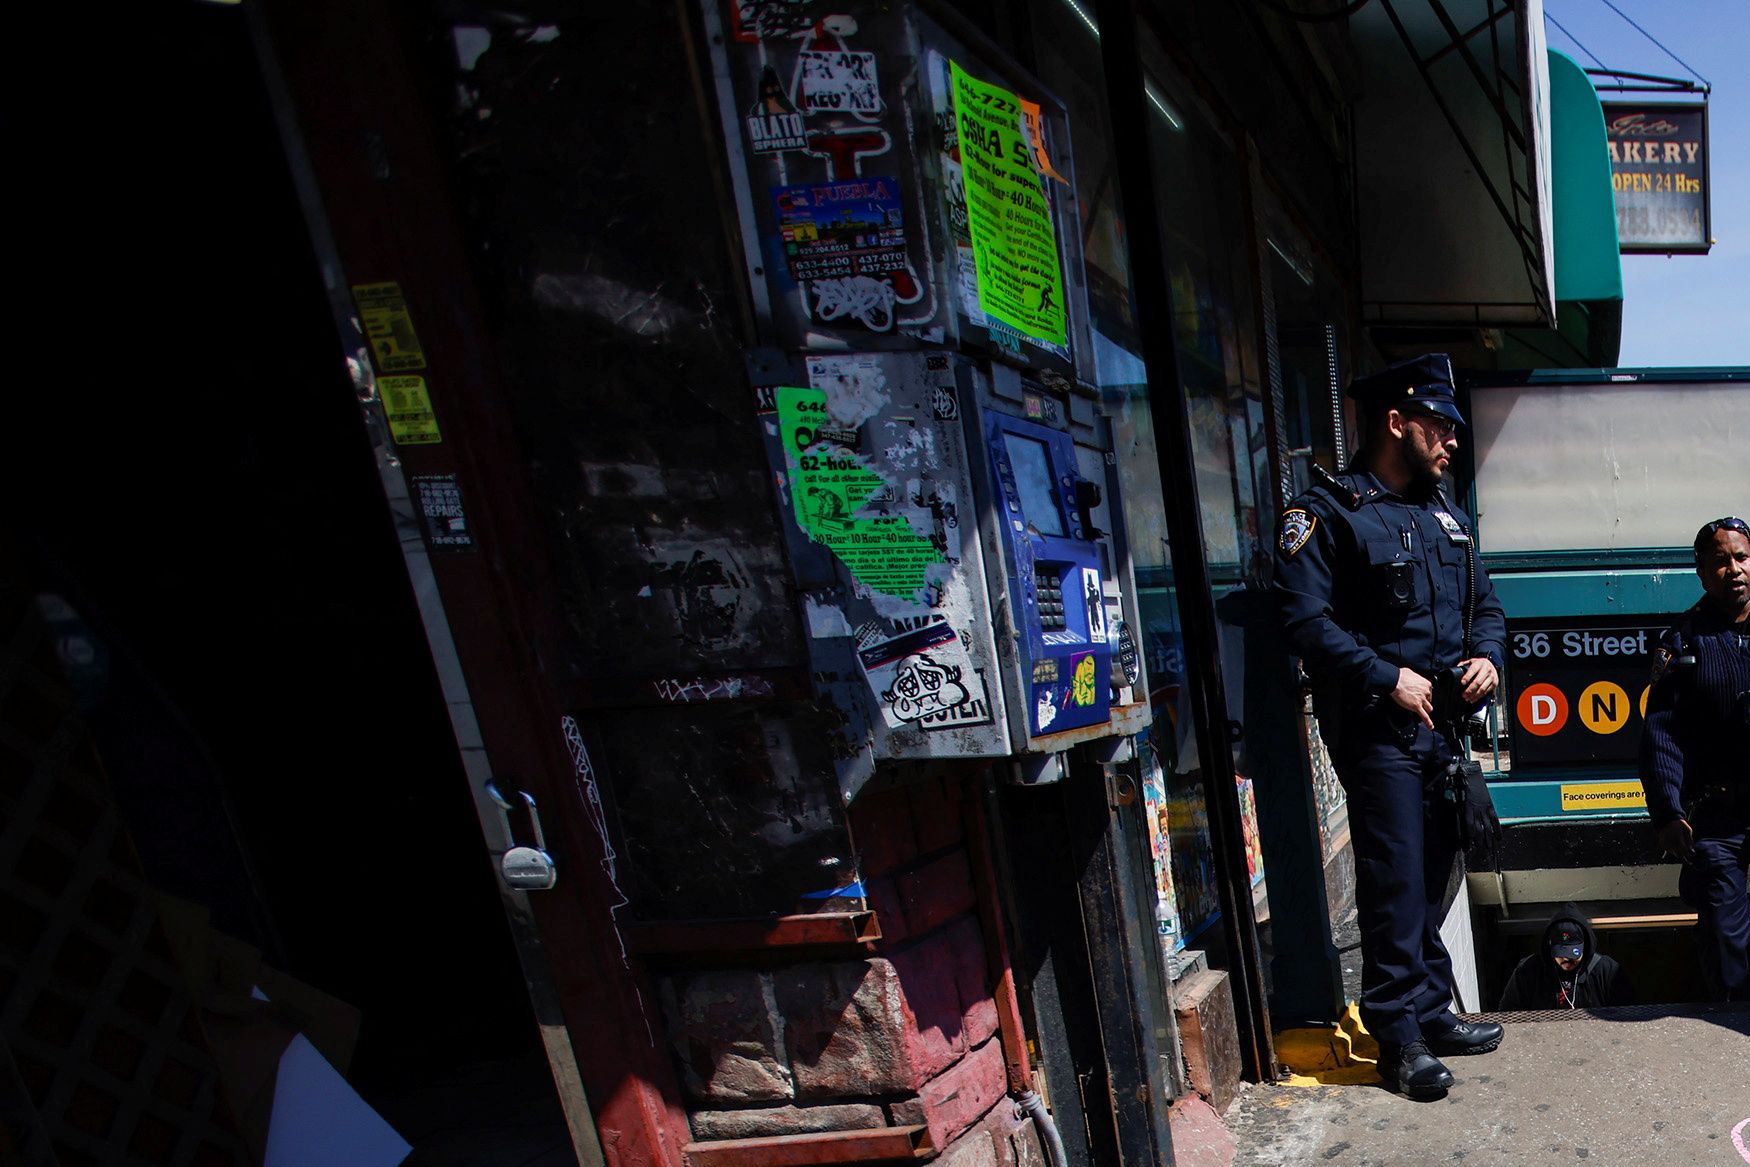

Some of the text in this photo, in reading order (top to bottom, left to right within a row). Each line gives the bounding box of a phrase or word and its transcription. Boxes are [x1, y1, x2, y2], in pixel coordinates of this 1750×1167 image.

[962, 113, 1005, 159] OSHA
[1614, 173, 1701, 193] OPEN 24 Hrs
[859, 252, 907, 267] 437-070
[1513, 629, 1648, 659] 36 Street
[1531, 692, 1618, 726] D N
[1563, 792, 1585, 801] Face
[1585, 790, 1626, 801] coverings
